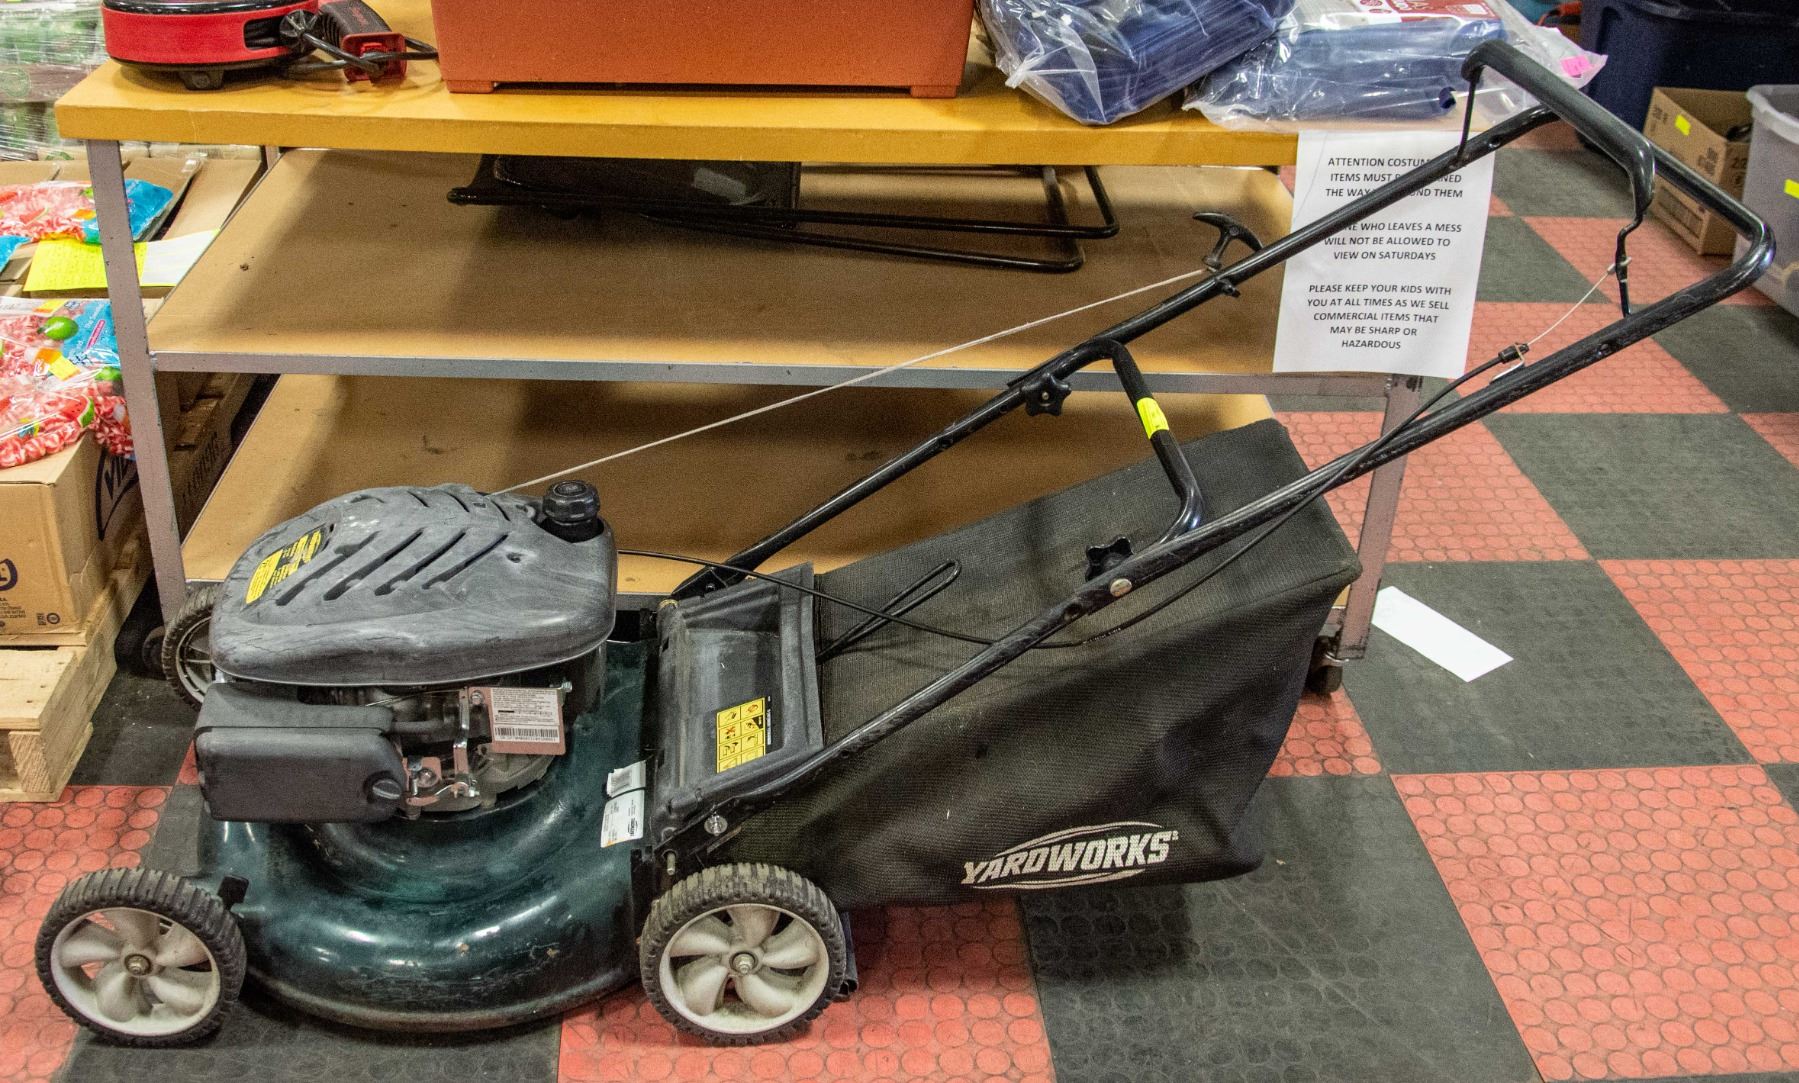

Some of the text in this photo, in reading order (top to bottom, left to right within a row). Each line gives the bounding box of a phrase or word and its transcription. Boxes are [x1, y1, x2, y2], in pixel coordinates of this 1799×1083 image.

[1328, 158, 1384, 167] ATTENTION
[1330, 173, 1360, 182] ITEMS
[1363, 173, 1392, 182] MUST
[1326, 188, 1344, 197] THE
[1347, 188, 1371, 197] WAY
[1434, 188, 1463, 198] THEM
[1360, 223, 1385, 231] WHO
[1388, 223, 1422, 231] LEAVES
[1425, 223, 1431, 231] A
[1435, 223, 1462, 233] MESS
[1324, 237, 1451, 247] WILL NOT BE ALLOWED TO
[1334, 251, 1436, 260] VIEW ON SATURDAYS
[1309, 284, 1452, 295] PLEASE KEEP YOUR KIDS WITH
[1307, 298, 1449, 310] YOU AT ALL TIMES AS WE SELL
[1313, 312, 1439, 323] COMMERCIAL ITEMS THAT
[1330, 326, 1417, 336] MAY BE SHARP OR
[1341, 340, 1401, 349] HAZARDOUS
[961, 831, 1172, 884] YARDWORKS
